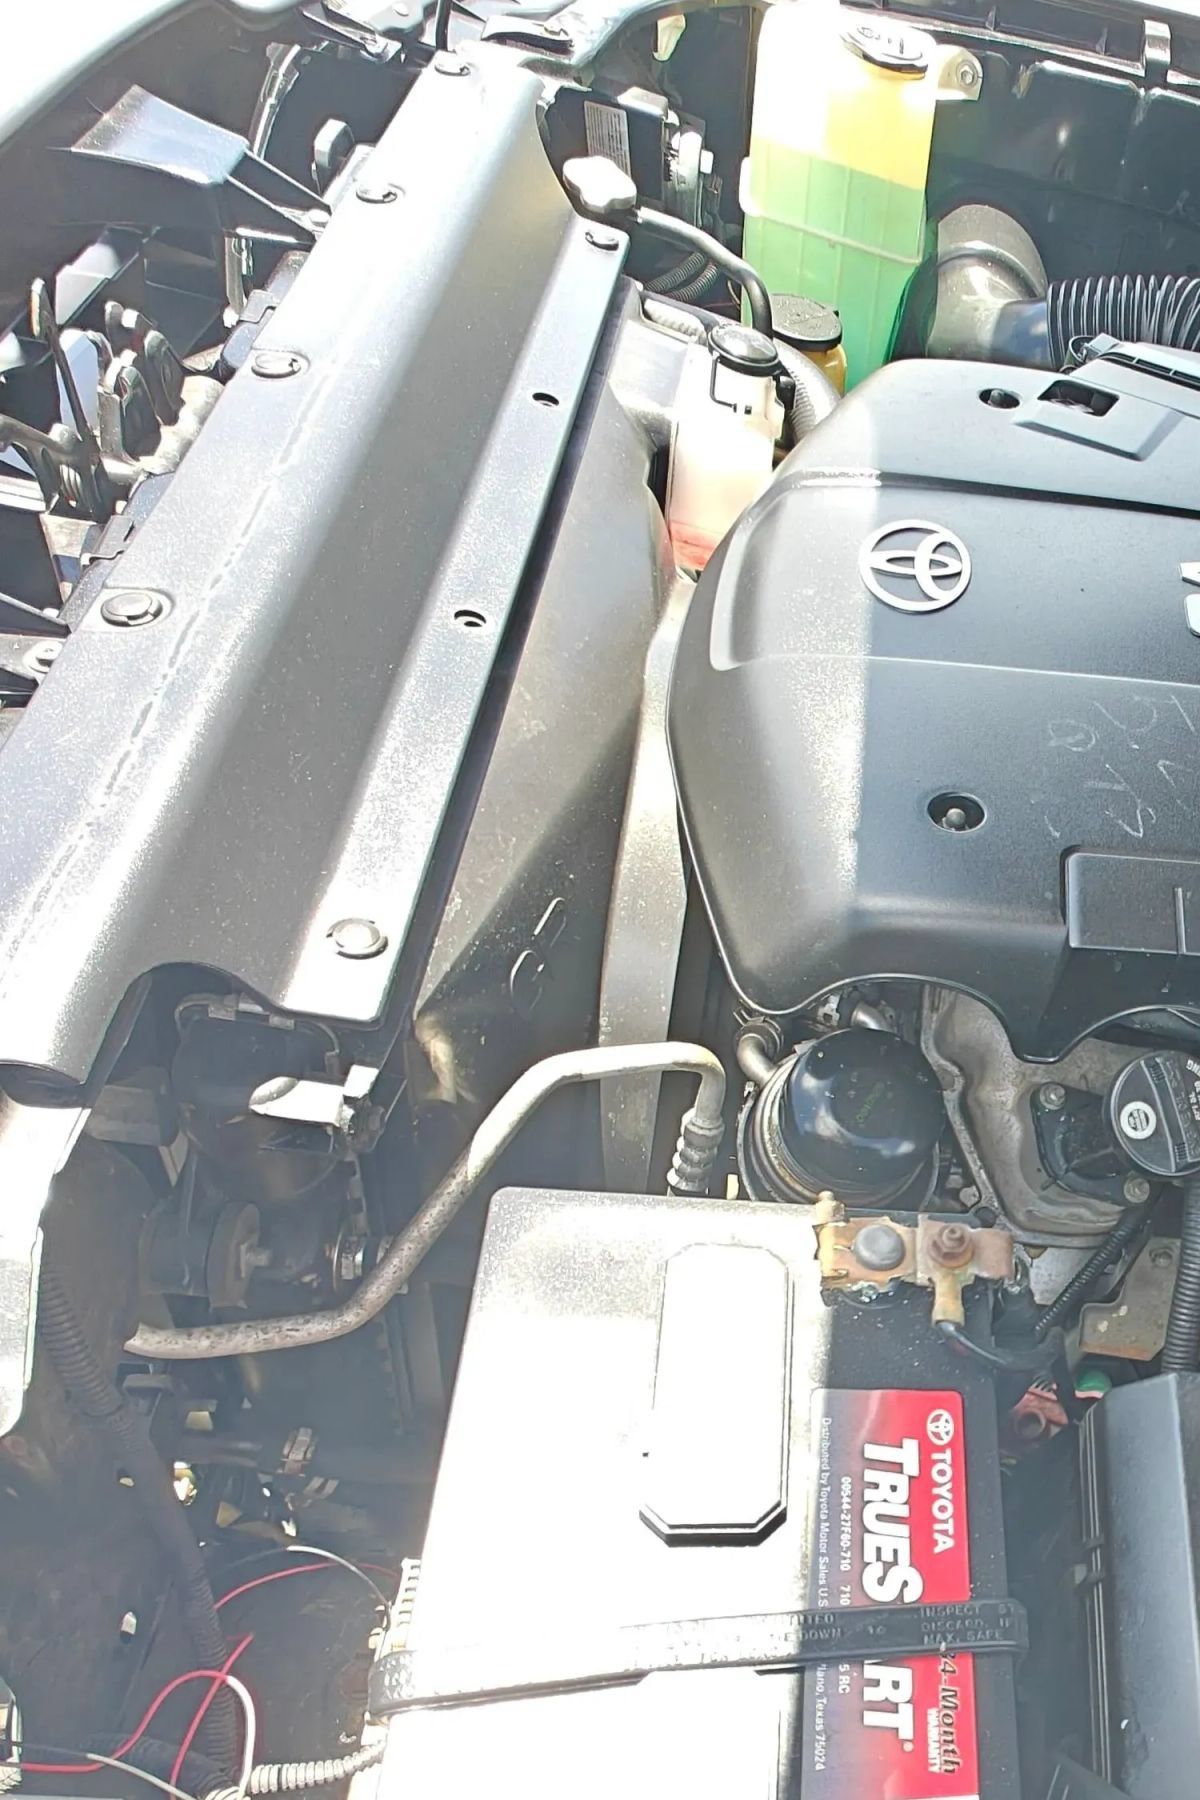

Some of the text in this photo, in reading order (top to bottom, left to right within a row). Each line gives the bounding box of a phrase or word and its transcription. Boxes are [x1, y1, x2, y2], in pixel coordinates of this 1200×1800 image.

[821, 1417, 832, 1470] Distributed
[820, 1472, 830, 1485] by
[820, 1486, 831, 1520] Toyota
[930, 1448, 955, 1554] TOYOTA
[819, 1522, 830, 1553] Motor
[818, 1556, 829, 1585] Sales
[838, 1675, 850, 1694] RC
[815, 1696, 827, 1731] Texas
[815, 1732, 826, 1771] 75024
[927, 1707, 942, 1773] WARRANTY
